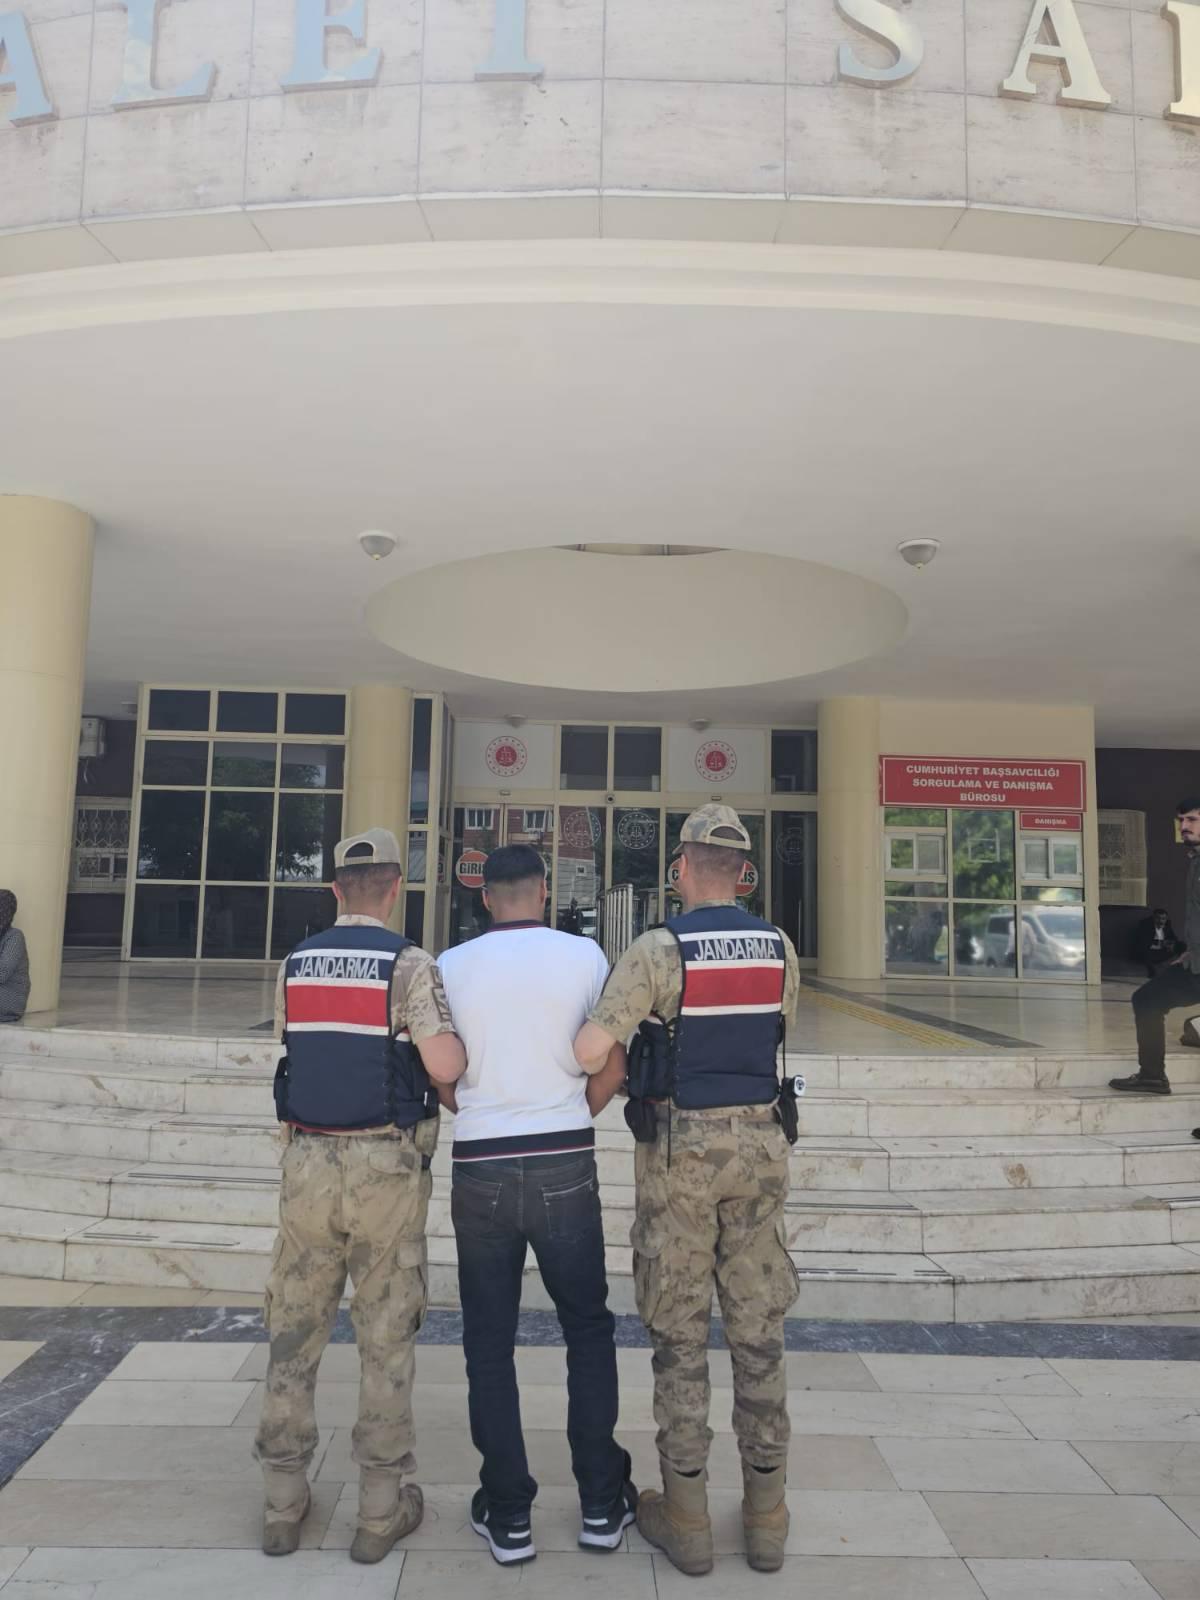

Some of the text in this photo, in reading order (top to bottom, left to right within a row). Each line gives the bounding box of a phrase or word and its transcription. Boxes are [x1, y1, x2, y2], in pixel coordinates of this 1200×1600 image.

[906, 764, 1060, 778] CUMHURİYET BAŞSAVCILIĞI
[912, 778, 1054, 791] SORGULAMA VE DANIŞMA
[959, 791, 1006, 802] BÜROSU
[694, 937, 778, 961] JANDARMA
[295, 956, 380, 979] JANDARMA
